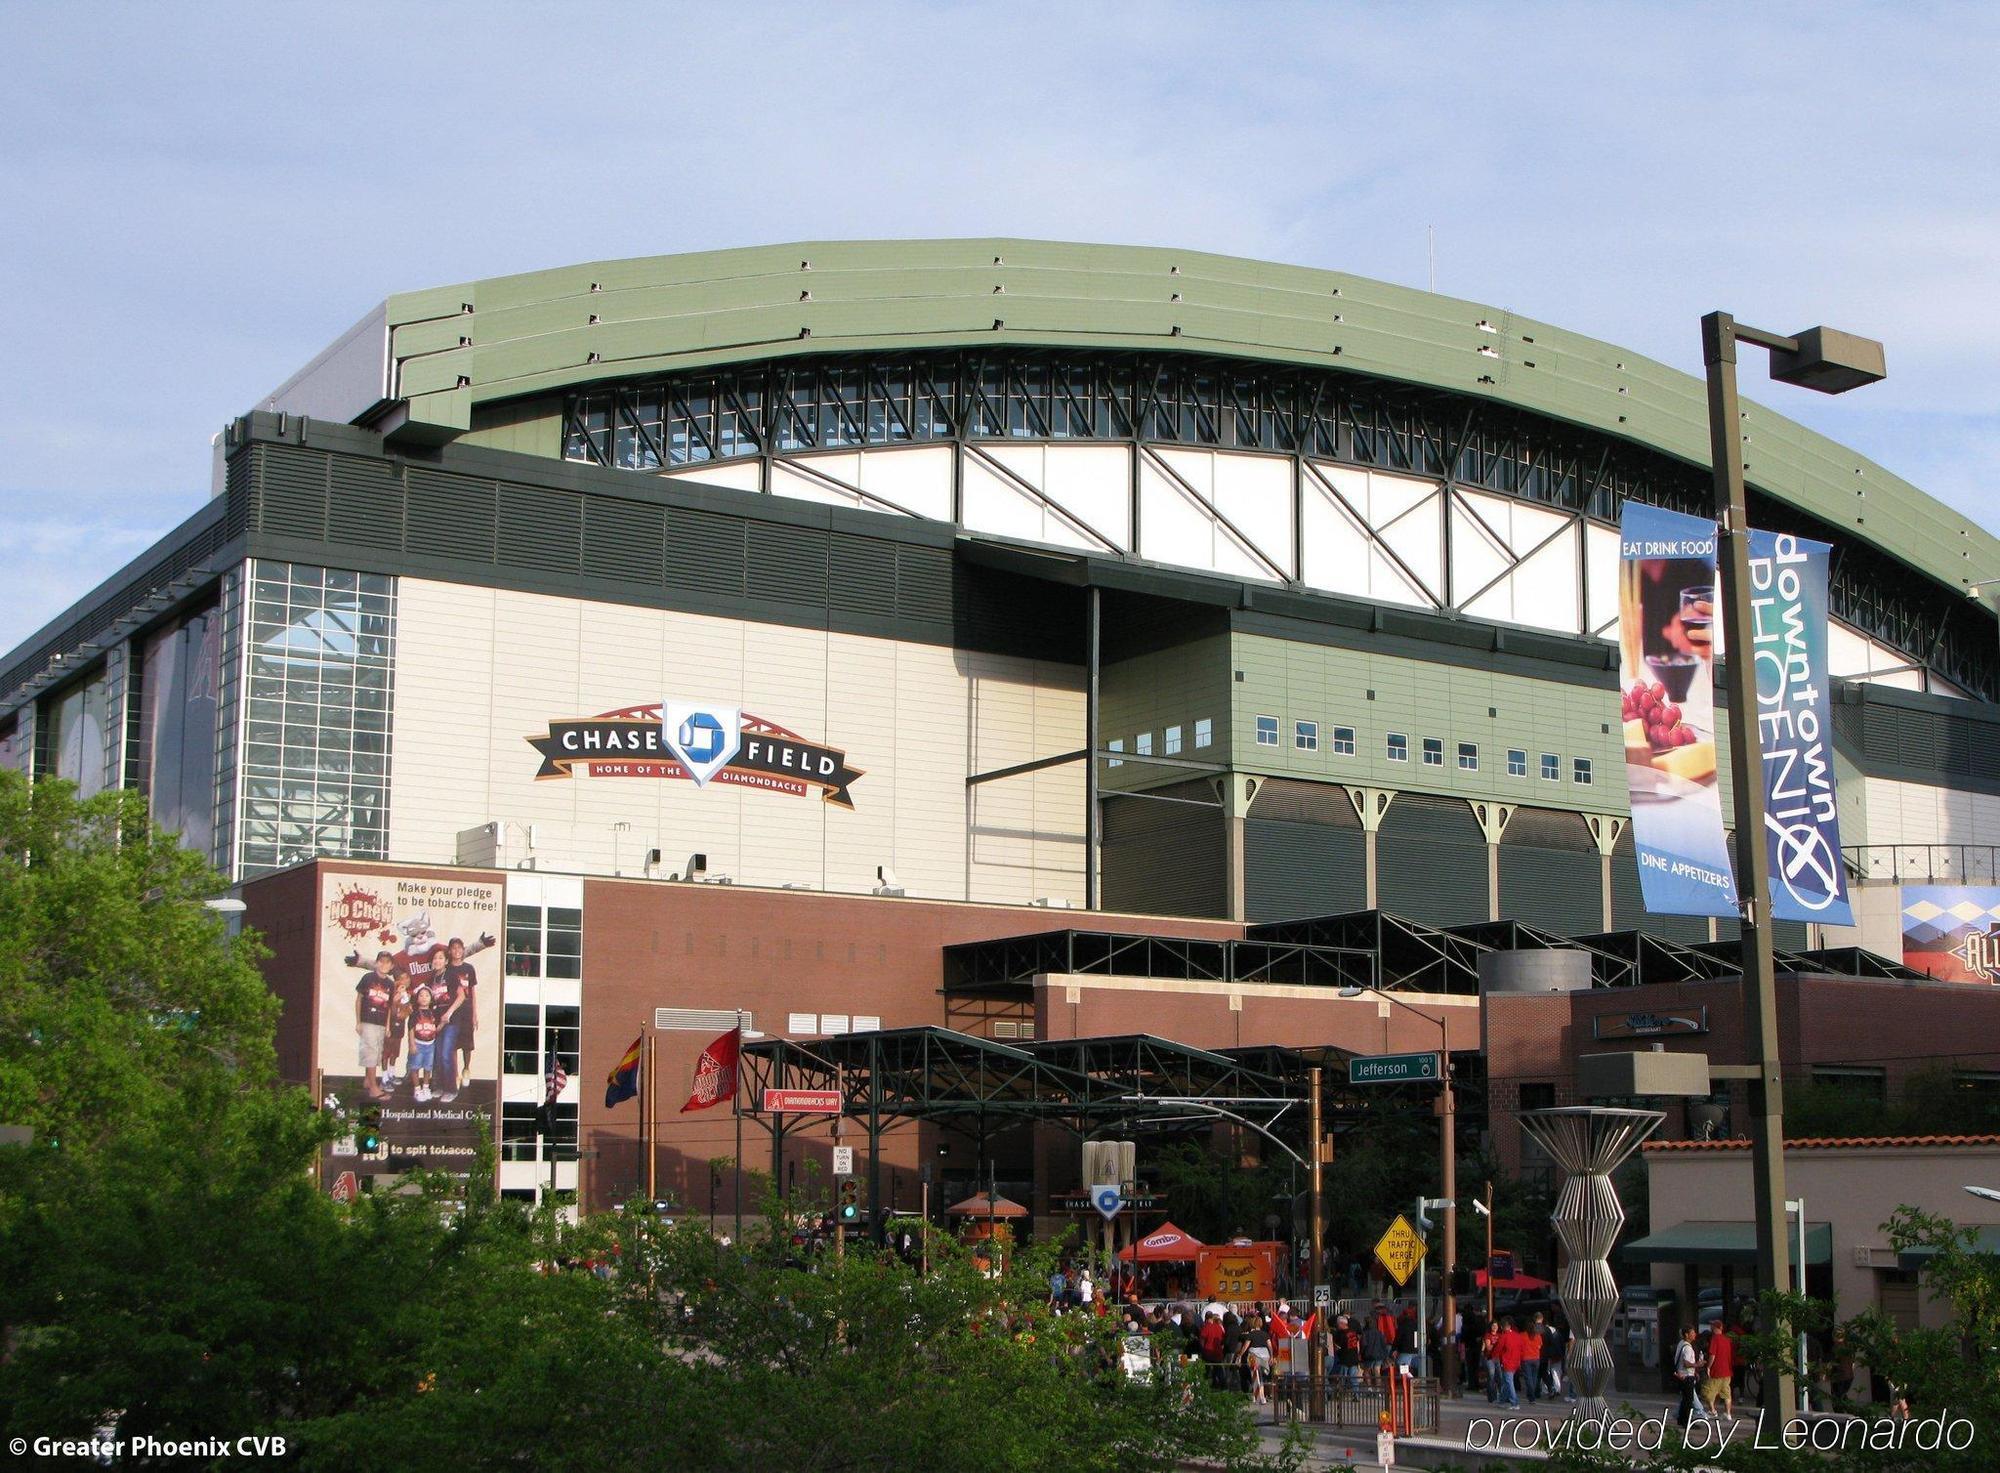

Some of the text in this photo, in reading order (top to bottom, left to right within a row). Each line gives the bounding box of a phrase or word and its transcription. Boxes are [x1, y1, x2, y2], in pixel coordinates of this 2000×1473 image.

[1623, 541, 1713, 556] EAT DRINK FOOD
[1774, 533, 1836, 822] downtown
[1748, 558, 1840, 910] PHOENIX
[562, 731, 836, 775] CHASE FIELD
[596, 764, 803, 793] HOME OF THE DIAMONDBACKS
[1641, 852, 1730, 889] DINE APPETIZERS
[397, 882, 492, 900] Make your pledge
[330, 899, 394, 923] No Chew
[397, 896, 497, 912] to be tobacco free!
[1358, 1063, 1408, 1077] Jefferson
[381, 1108, 414, 1121] Hospital
[415, 1109, 431, 1120] and
[433, 1109, 464, 1121] Medical
[391, 1144, 403, 1154] to
[406, 1144, 427, 1157] spit
[430, 1144, 477, 1156] tobacco.
[1391, 1230, 1411, 1238] THRU
[1387, 1240, 1416, 1249] TRAFFIC
[1389, 1251, 1414, 1260] MERGE
[1393, 1261, 1410, 1270] LEFT
[1315, 1289, 1330, 1302] 25
